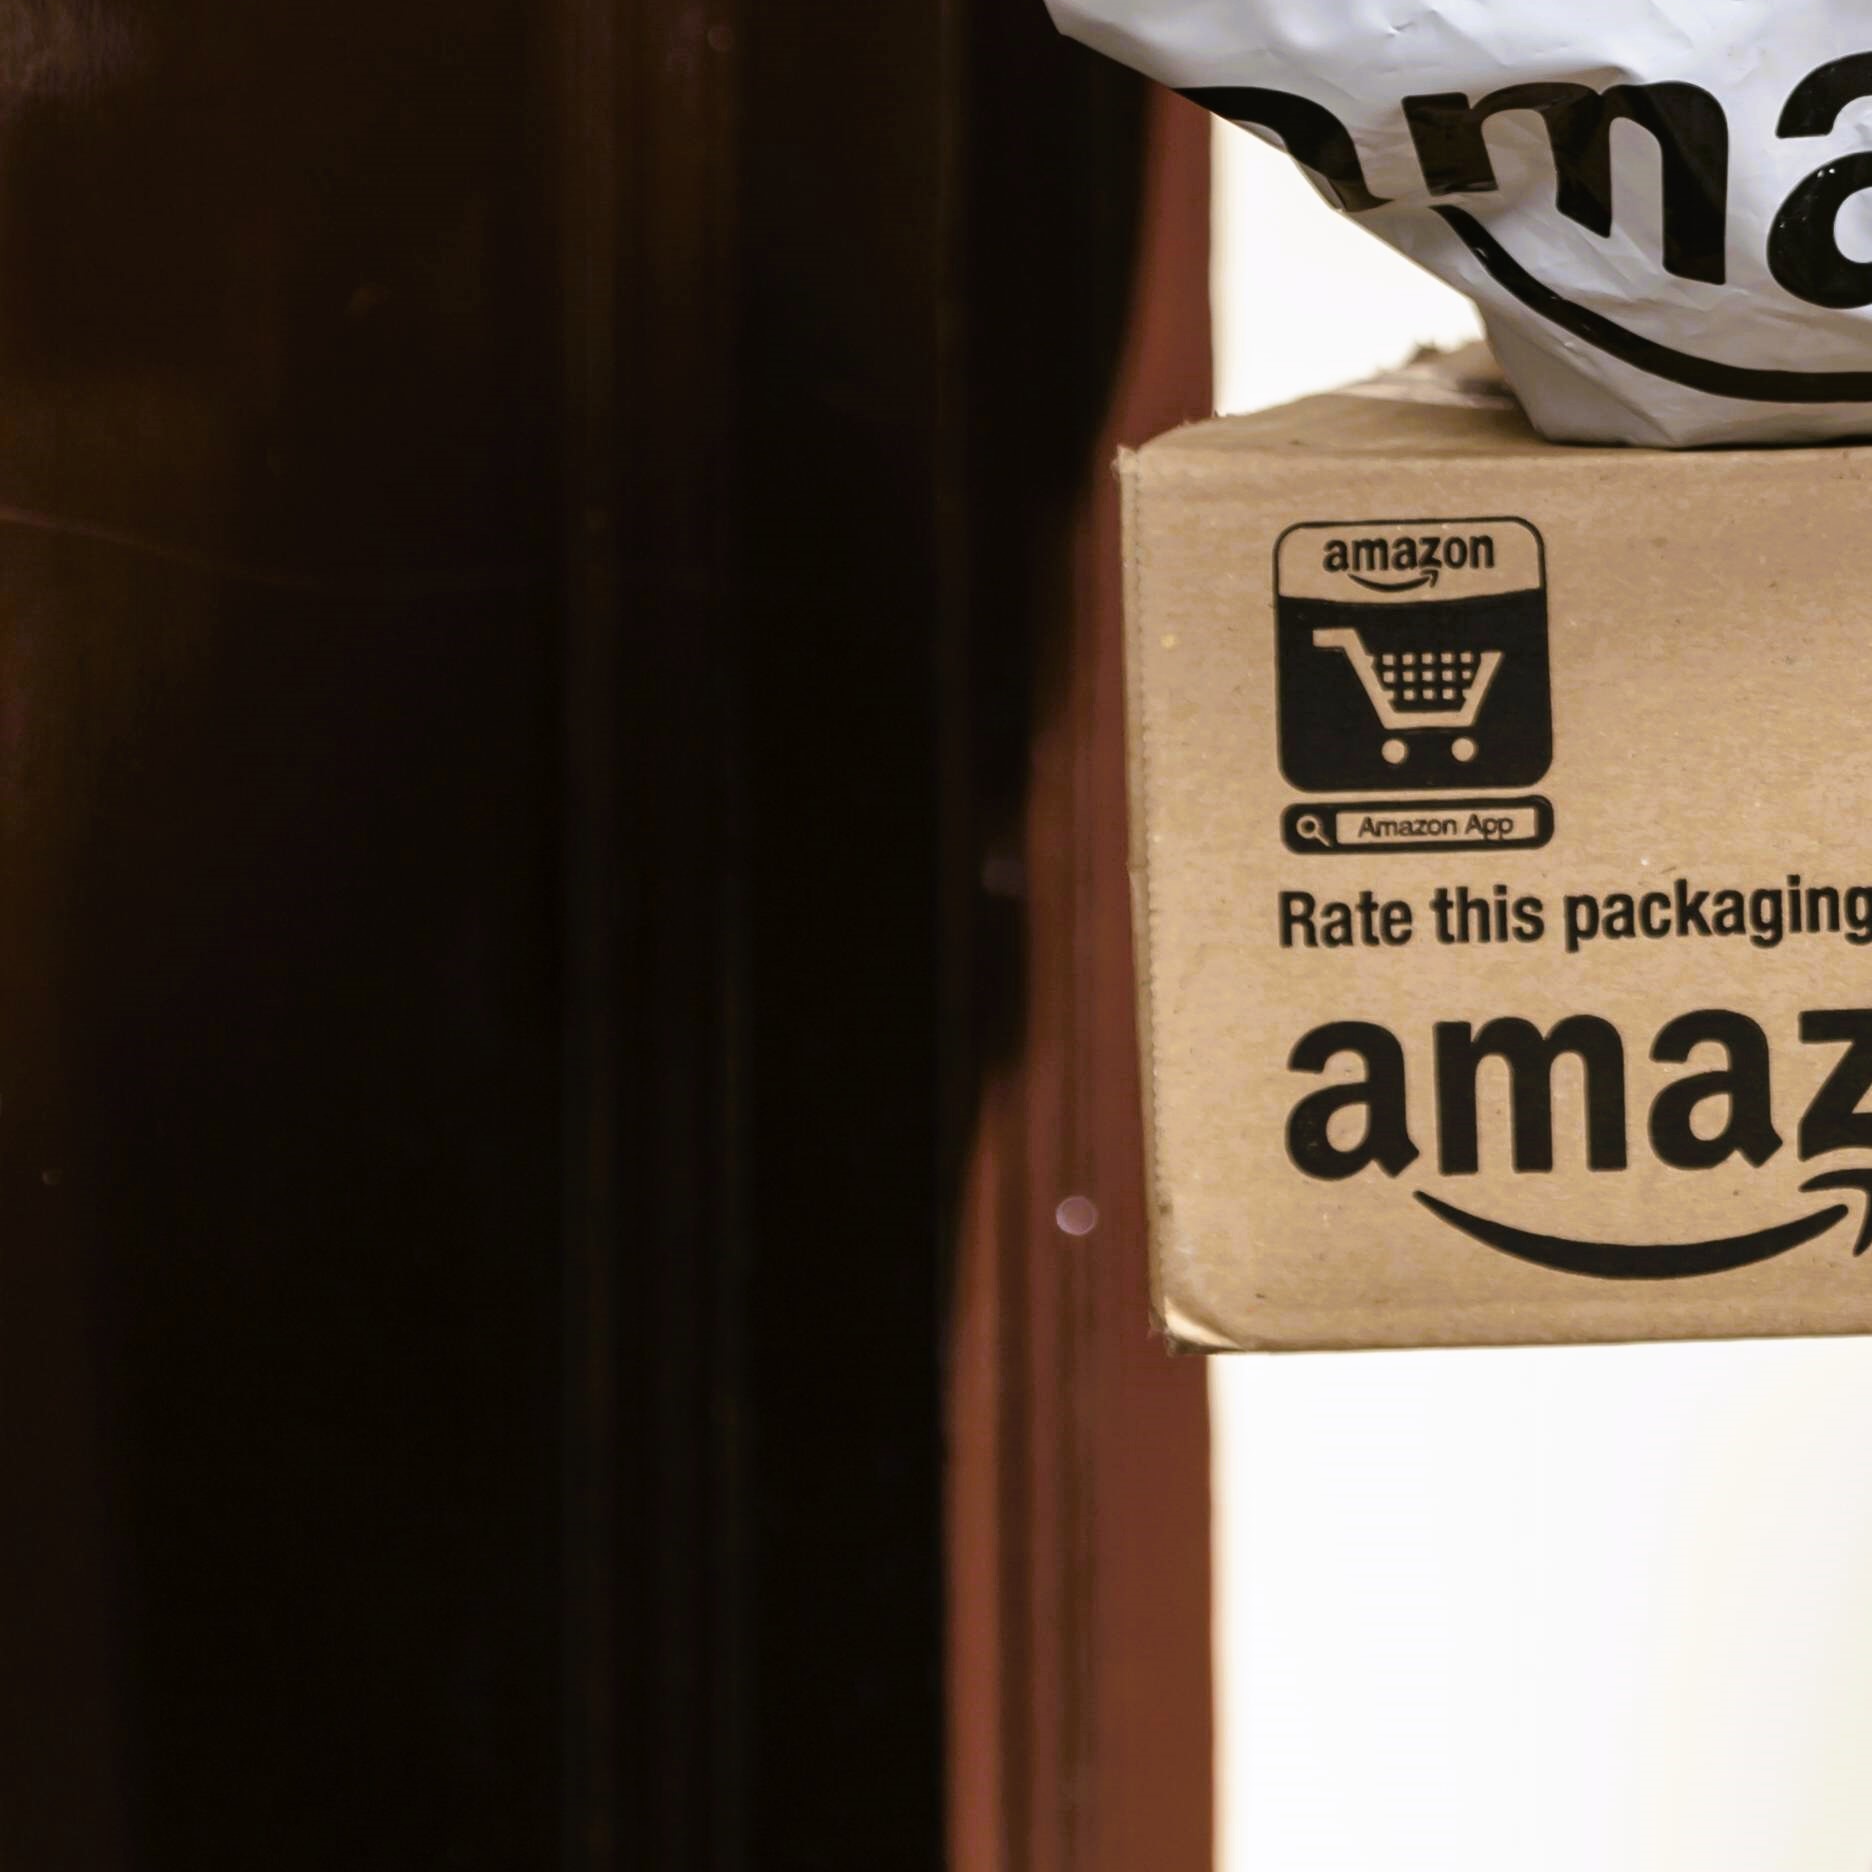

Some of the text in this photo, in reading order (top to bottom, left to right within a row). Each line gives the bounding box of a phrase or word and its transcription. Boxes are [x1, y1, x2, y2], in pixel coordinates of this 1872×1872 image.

[1322, 534, 1496, 572] amazon
[1358, 813, 1515, 841] Amazon App
[1279, 890, 1414, 949] Rate
[1431, 884, 1546, 946] this
